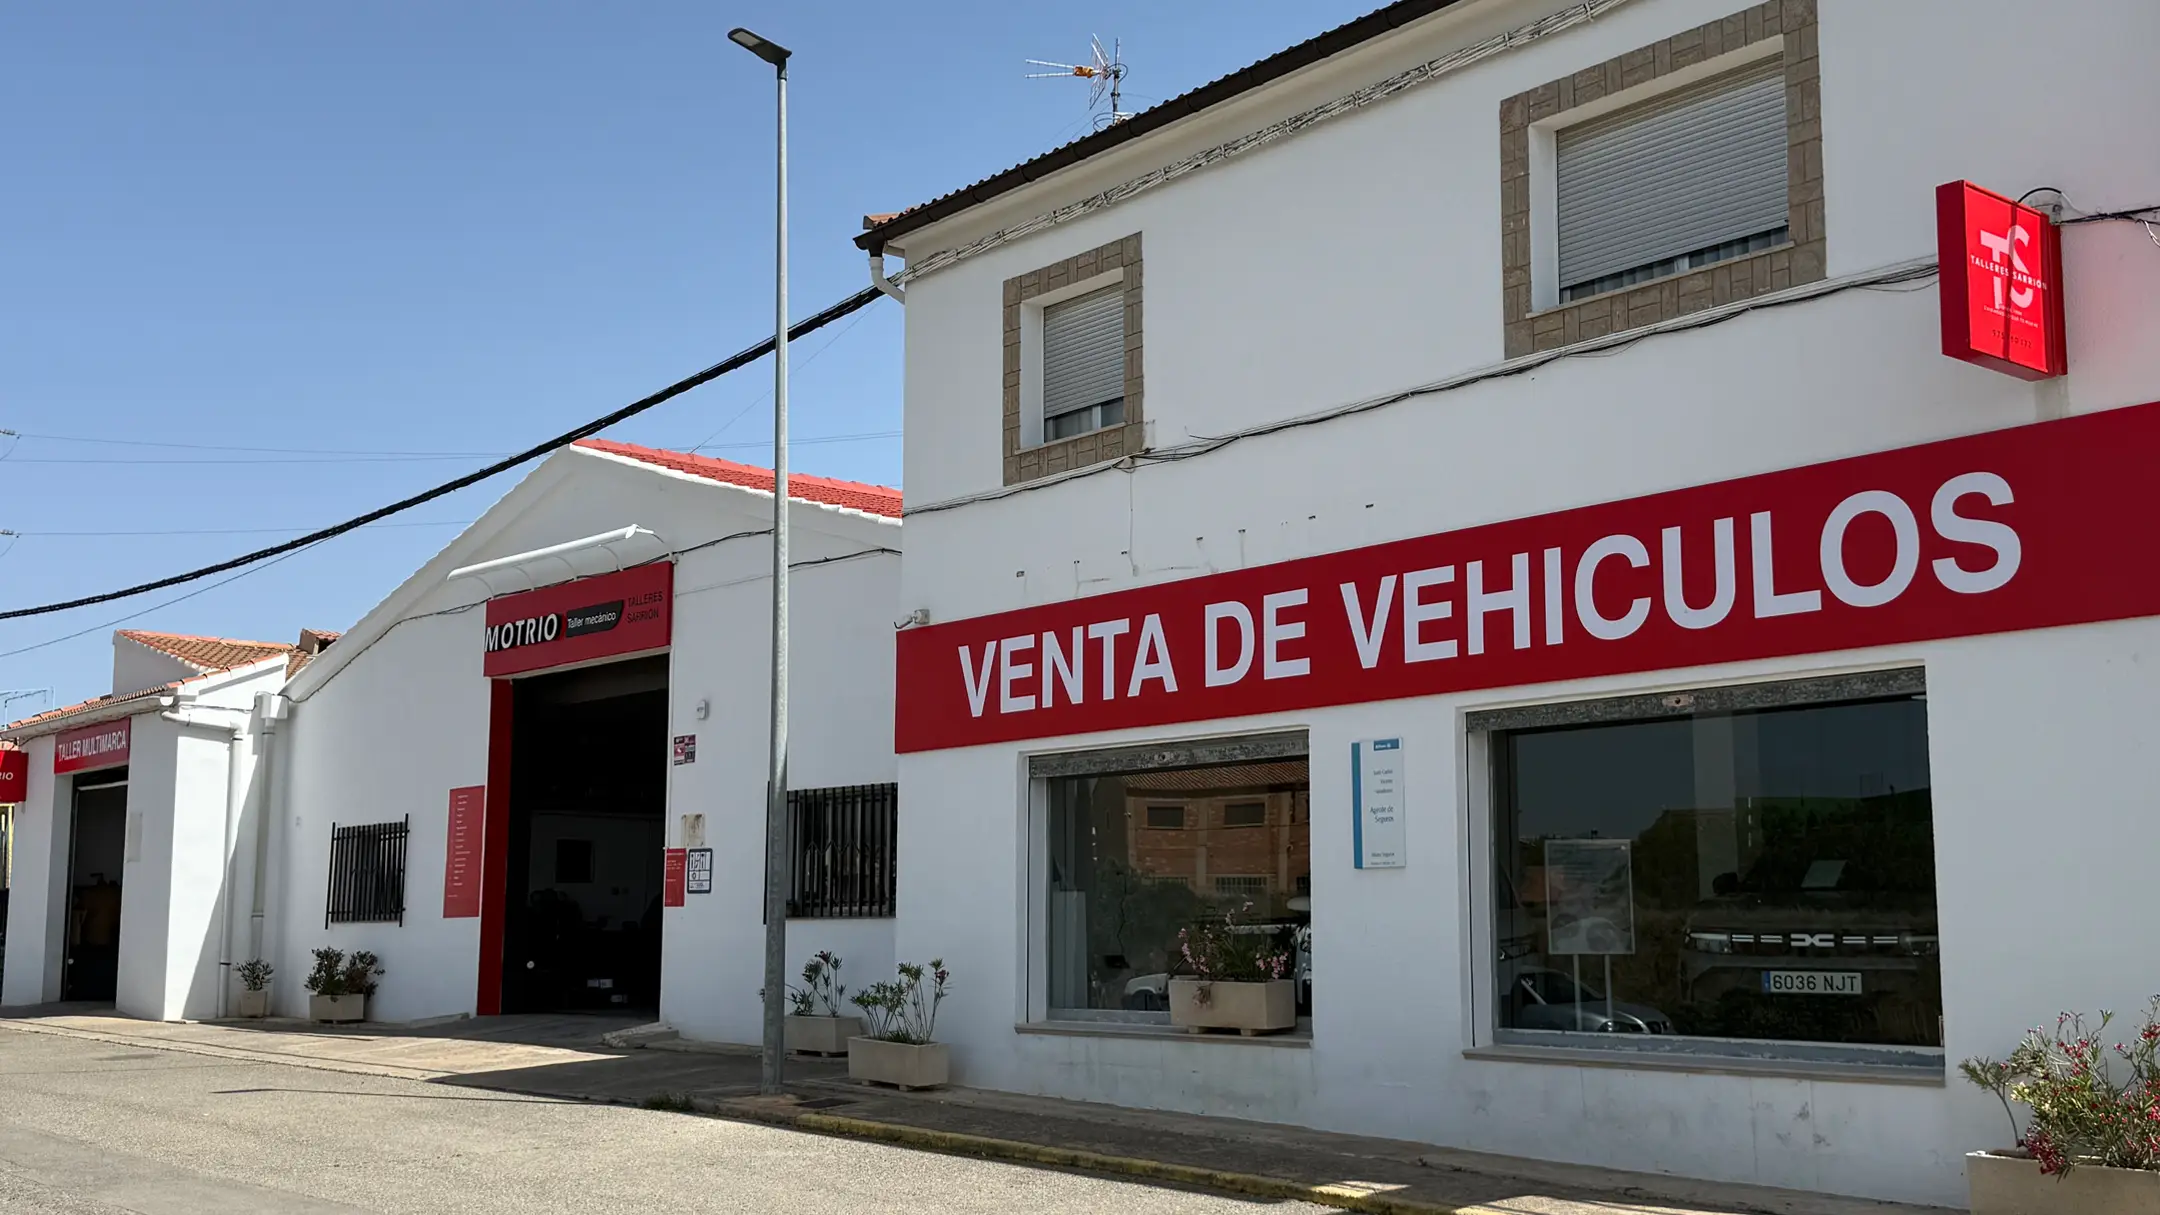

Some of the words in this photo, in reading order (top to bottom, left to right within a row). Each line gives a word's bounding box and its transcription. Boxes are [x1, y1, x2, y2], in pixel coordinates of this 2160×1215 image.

[1970, 254, 2009, 277] TALLERES
[628, 590, 663, 608] TALLERES
[958, 612, 1178, 718] VENTA
[1204, 588, 1310, 688] DE
[1339, 471, 2023, 669] VEHICULOS
[484, 613, 558, 652] MOTRIO
[567, 616, 584, 629] Taller
[58, 740, 81, 762] TALLER
[82, 730, 126, 757] MULTIMARCA
[1772, 975, 1817, 990] 6036
[1823, 975, 1857, 992] NJT
